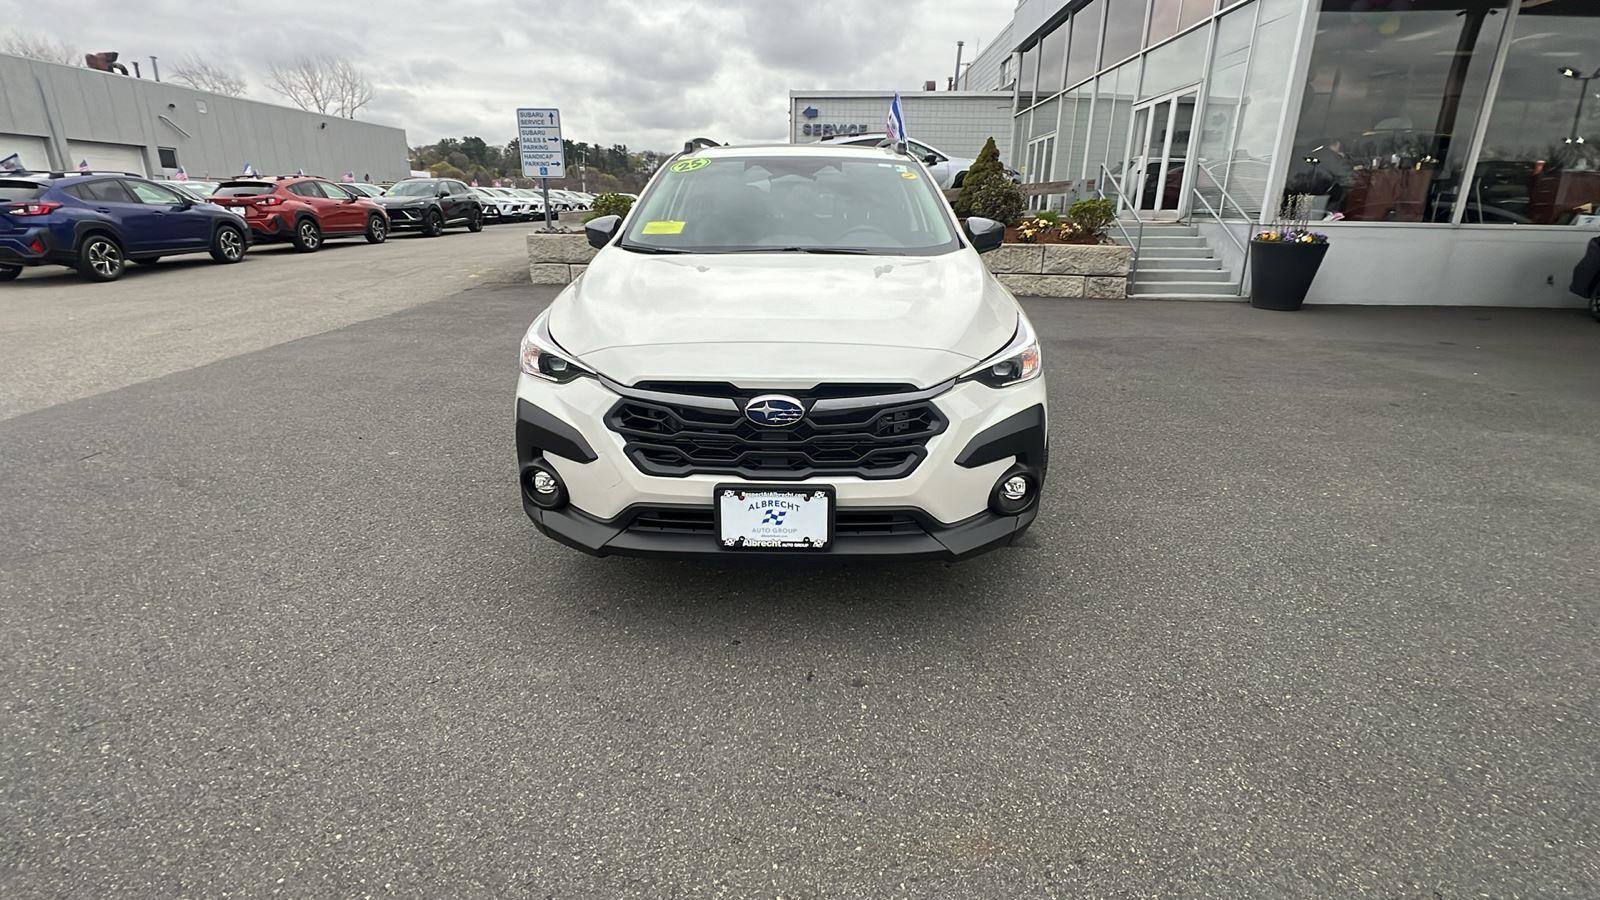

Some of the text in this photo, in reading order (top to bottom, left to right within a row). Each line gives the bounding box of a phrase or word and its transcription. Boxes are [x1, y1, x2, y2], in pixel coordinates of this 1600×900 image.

[803, 123, 868, 136] SERVICE
[748, 500, 800, 512] ALBRECHT
[742, 539, 782, 547] Albrecht
